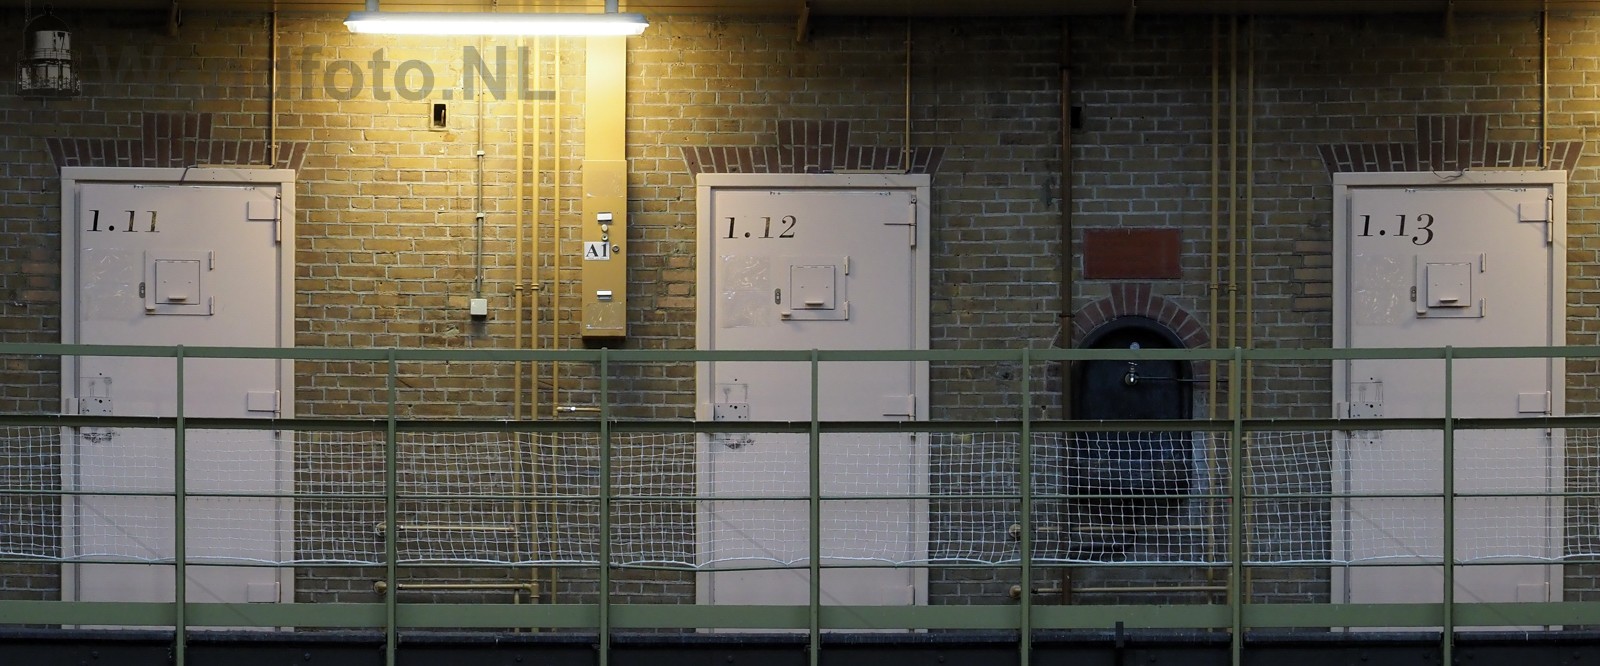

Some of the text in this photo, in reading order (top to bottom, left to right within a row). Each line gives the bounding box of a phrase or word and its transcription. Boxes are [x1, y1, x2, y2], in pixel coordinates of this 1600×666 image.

[86, 209, 160, 233] 1.11
[722, 214, 797, 239] 1.12
[1357, 213, 1434, 246] 1.13
[586, 243, 607, 258] A1
